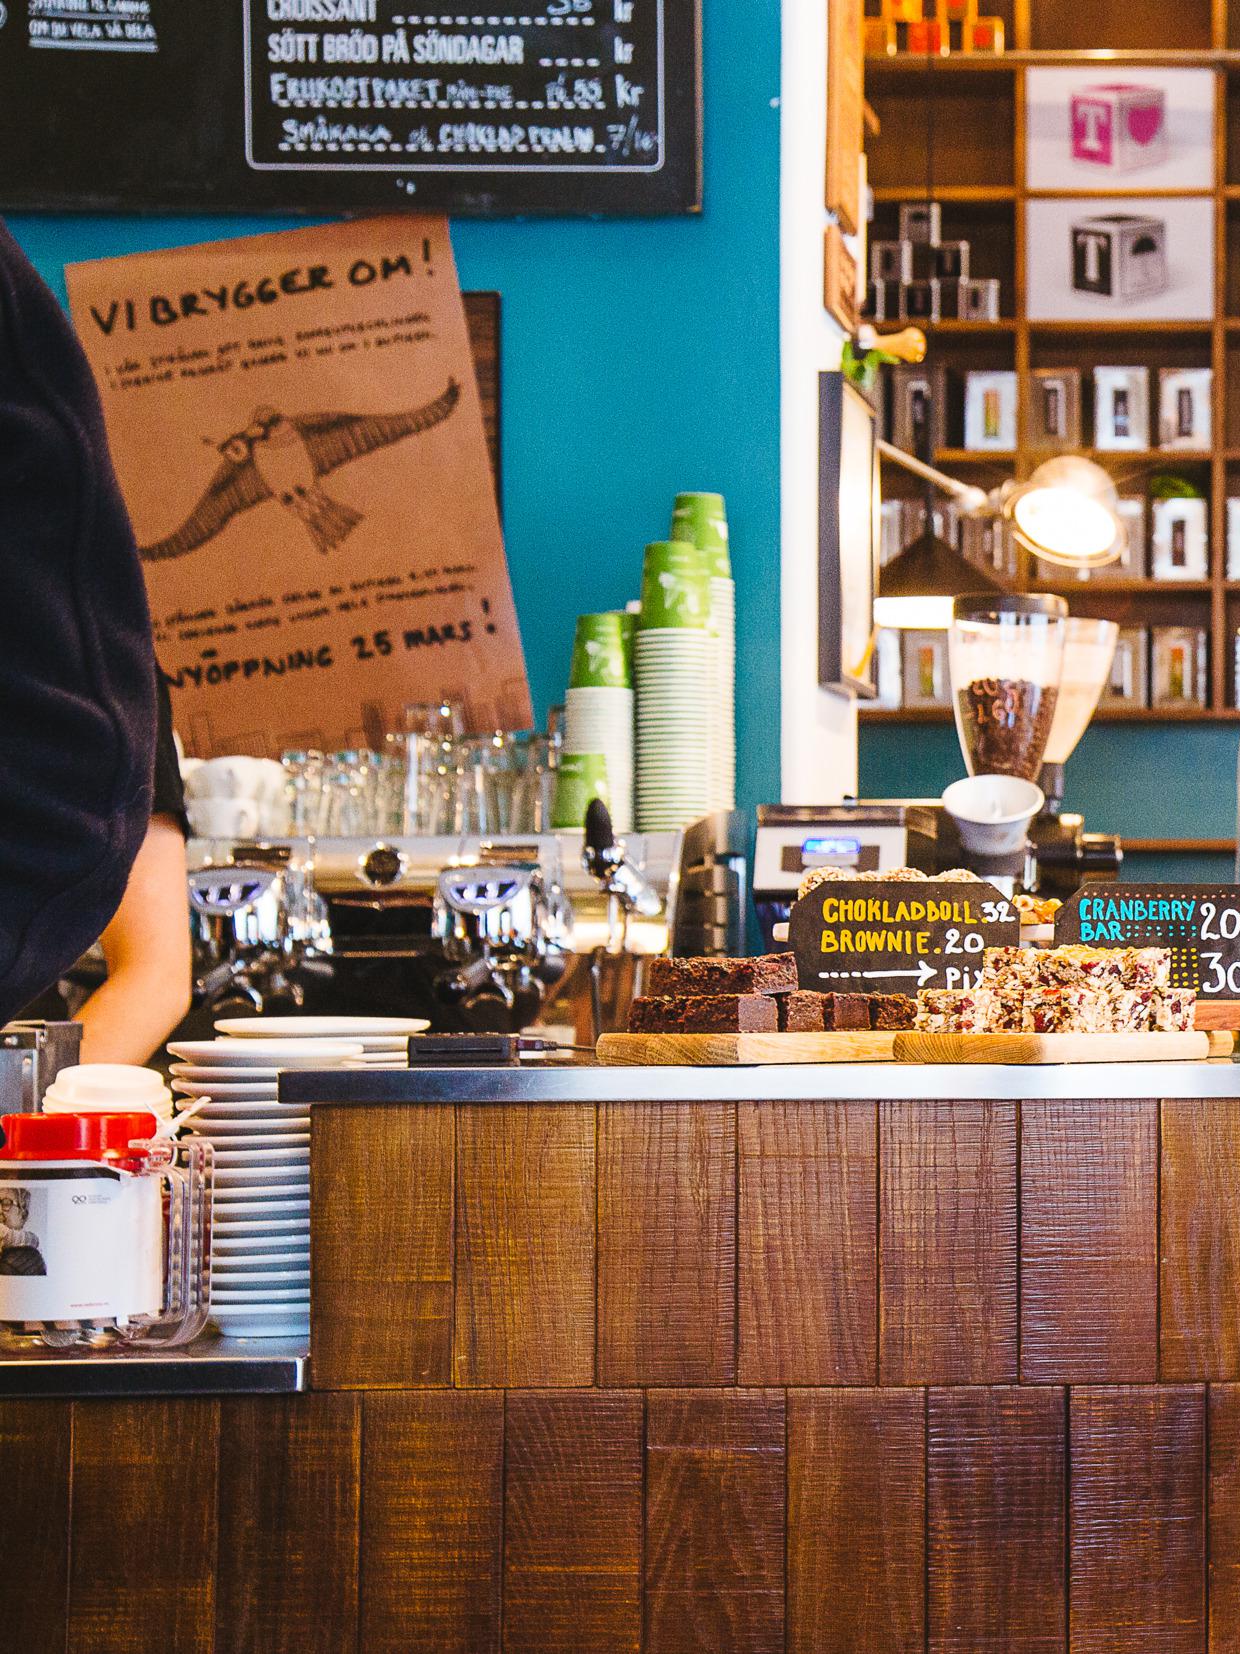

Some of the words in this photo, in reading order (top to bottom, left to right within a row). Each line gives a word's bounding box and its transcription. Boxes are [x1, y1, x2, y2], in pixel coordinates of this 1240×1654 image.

[267, 27, 319, 62] SÖTT
[323, 28, 379, 63] BRÖD
[381, 28, 410, 64] PÅ
[412, 29, 525, 65] SÖNDAGAR
[89, 300, 136, 336] VI
[149, 263, 334, 327] BRYGGER
[350, 629, 394, 662] 25
[981, 900, 1016, 922] 32
[1079, 898, 1196, 922] CRANBERRY
[944, 927, 986, 955] 20
[1080, 921, 1126, 942] BAR
